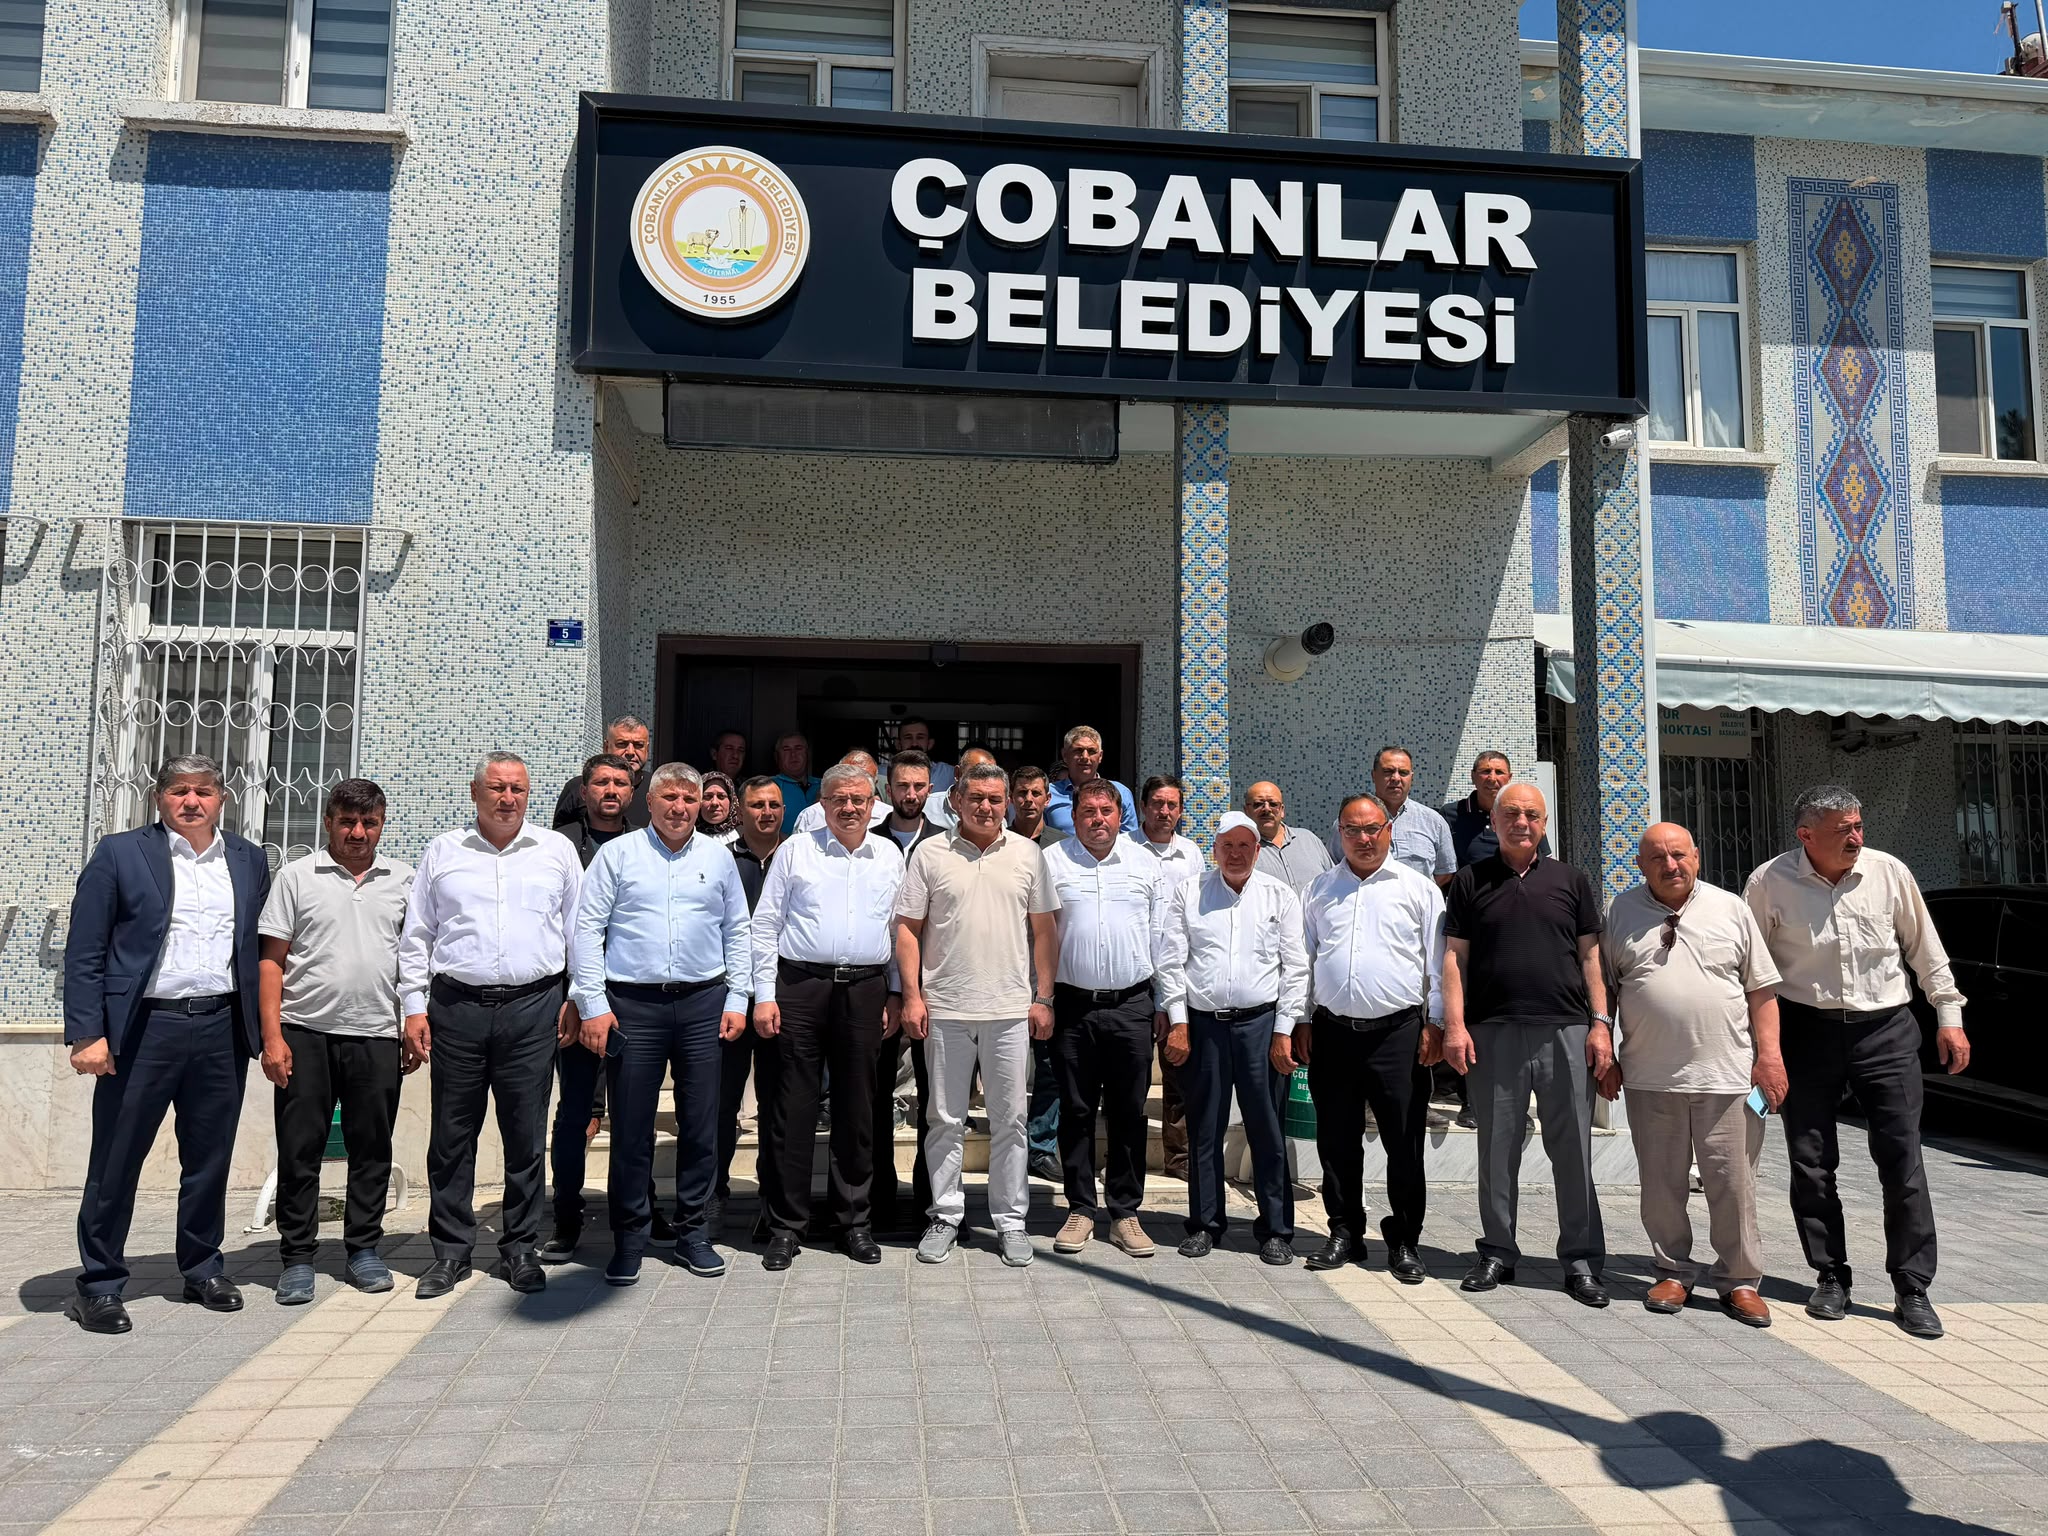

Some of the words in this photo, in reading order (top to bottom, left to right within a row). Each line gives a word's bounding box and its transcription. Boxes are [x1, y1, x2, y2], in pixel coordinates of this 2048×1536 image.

[644, 171, 686, 245] ÇOBANLAR
[759, 175, 797, 257] BELEDİYESİ
[891, 157, 1538, 270] ÇOBANLAR
[703, 294, 736, 305] 1955
[562, 628, 569, 639] 5
[1297, 1083, 1310, 1091] BEL
